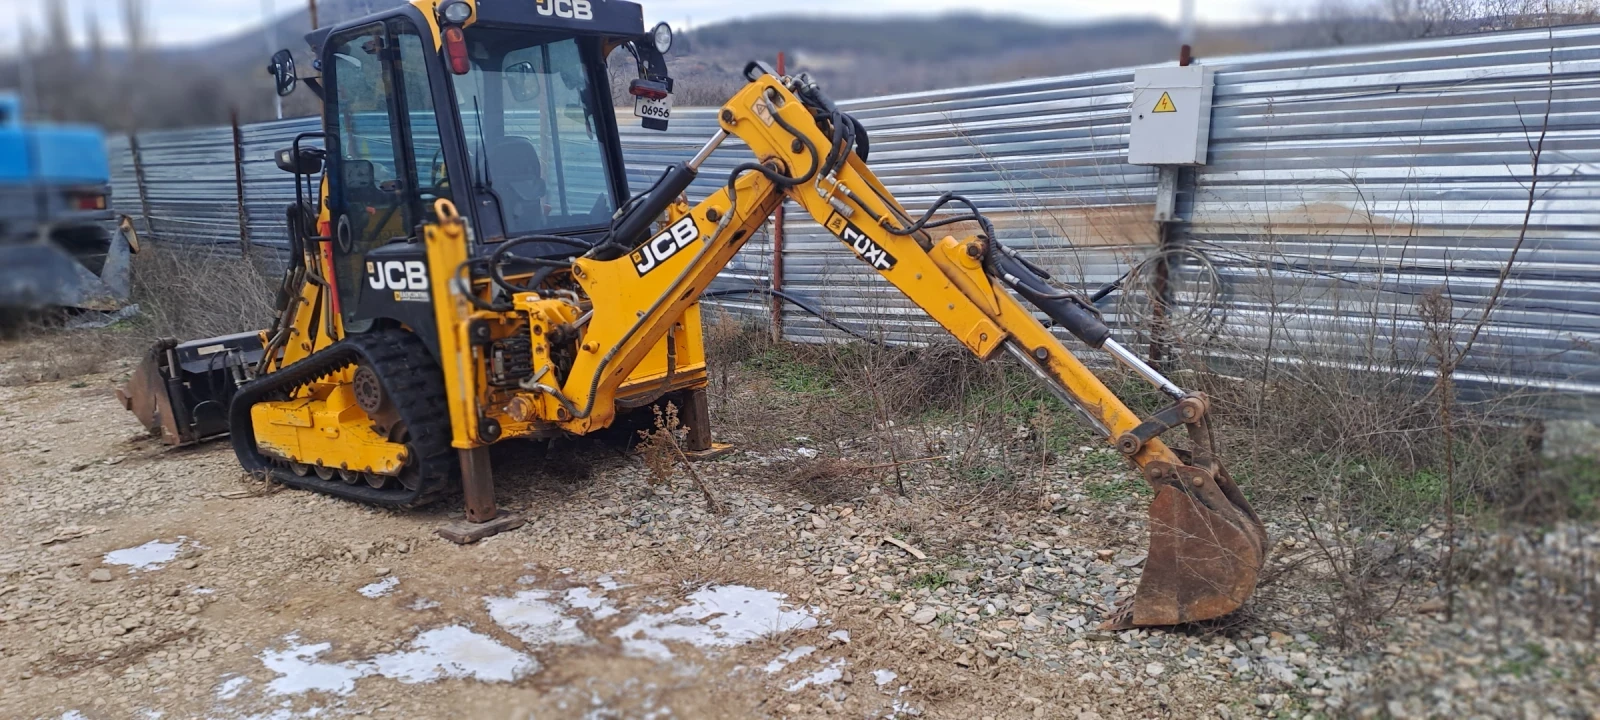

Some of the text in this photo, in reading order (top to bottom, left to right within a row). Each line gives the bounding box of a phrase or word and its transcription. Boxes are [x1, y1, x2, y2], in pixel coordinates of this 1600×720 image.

[536, 0, 593, 20] JCB
[641, 105, 670, 118] 06956
[637, 217, 698, 273] JCB
[844, 227, 891, 269] 1CXT
[368, 261, 428, 290] JCB
